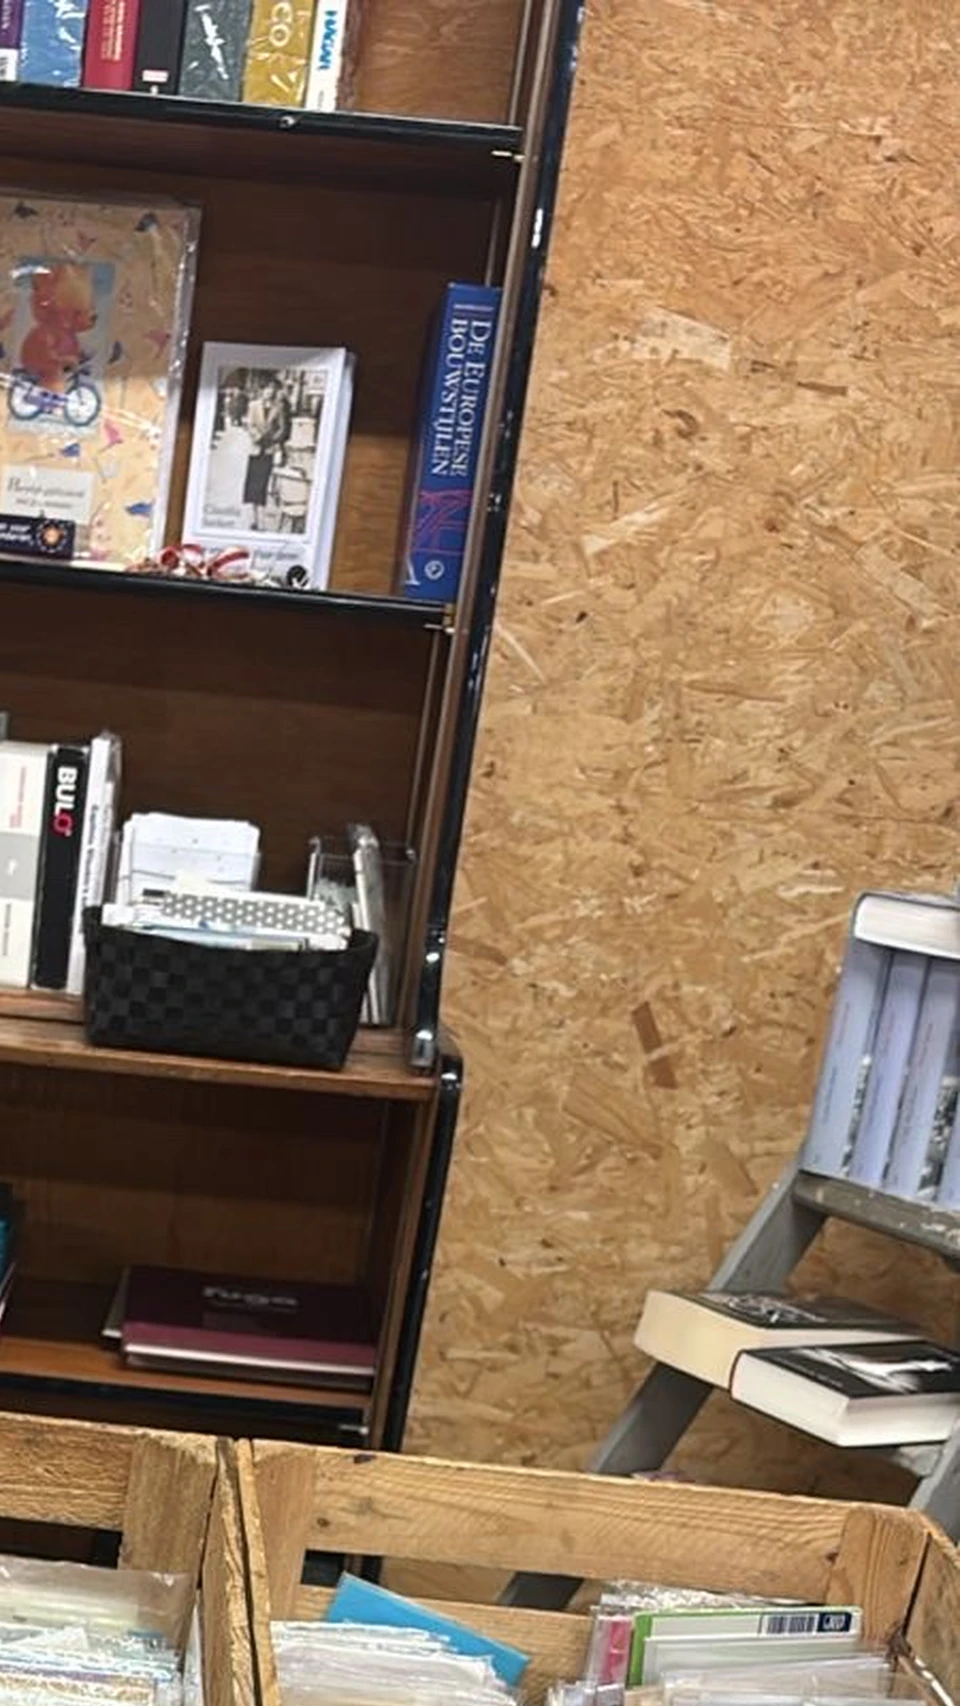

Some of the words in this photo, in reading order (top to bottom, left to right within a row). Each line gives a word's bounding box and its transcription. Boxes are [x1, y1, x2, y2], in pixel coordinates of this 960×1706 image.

[469, 319, 492, 356] DE
[431, 318, 468, 477] BOUWSTIJLEN
[451, 361, 486, 477] EUROPESE
